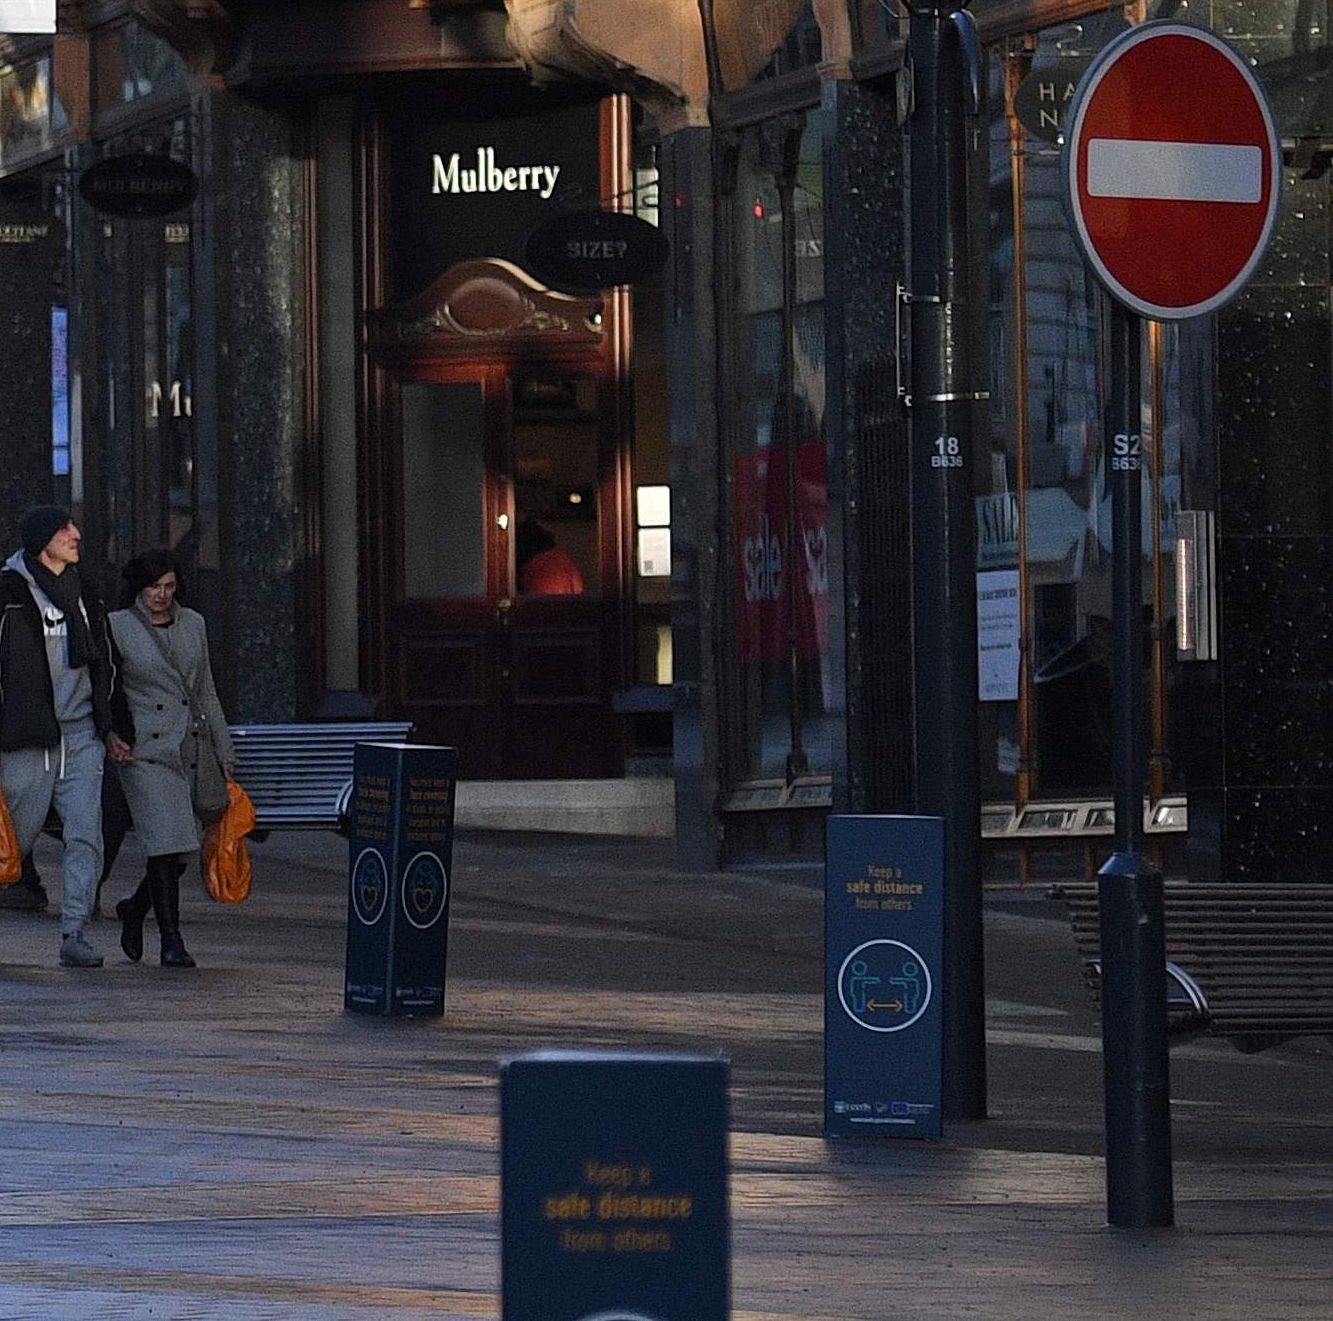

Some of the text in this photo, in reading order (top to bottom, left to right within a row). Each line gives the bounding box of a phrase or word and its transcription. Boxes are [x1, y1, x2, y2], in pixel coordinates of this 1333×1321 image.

[432, 146, 560, 199] Mulberry
[566, 242, 628, 259] SIZE?
[934, 436, 960, 455] 18
[1113, 434, 1141, 455] S2
[846, 879, 923, 894] safe distance
[598, 1191, 693, 1220] distance
